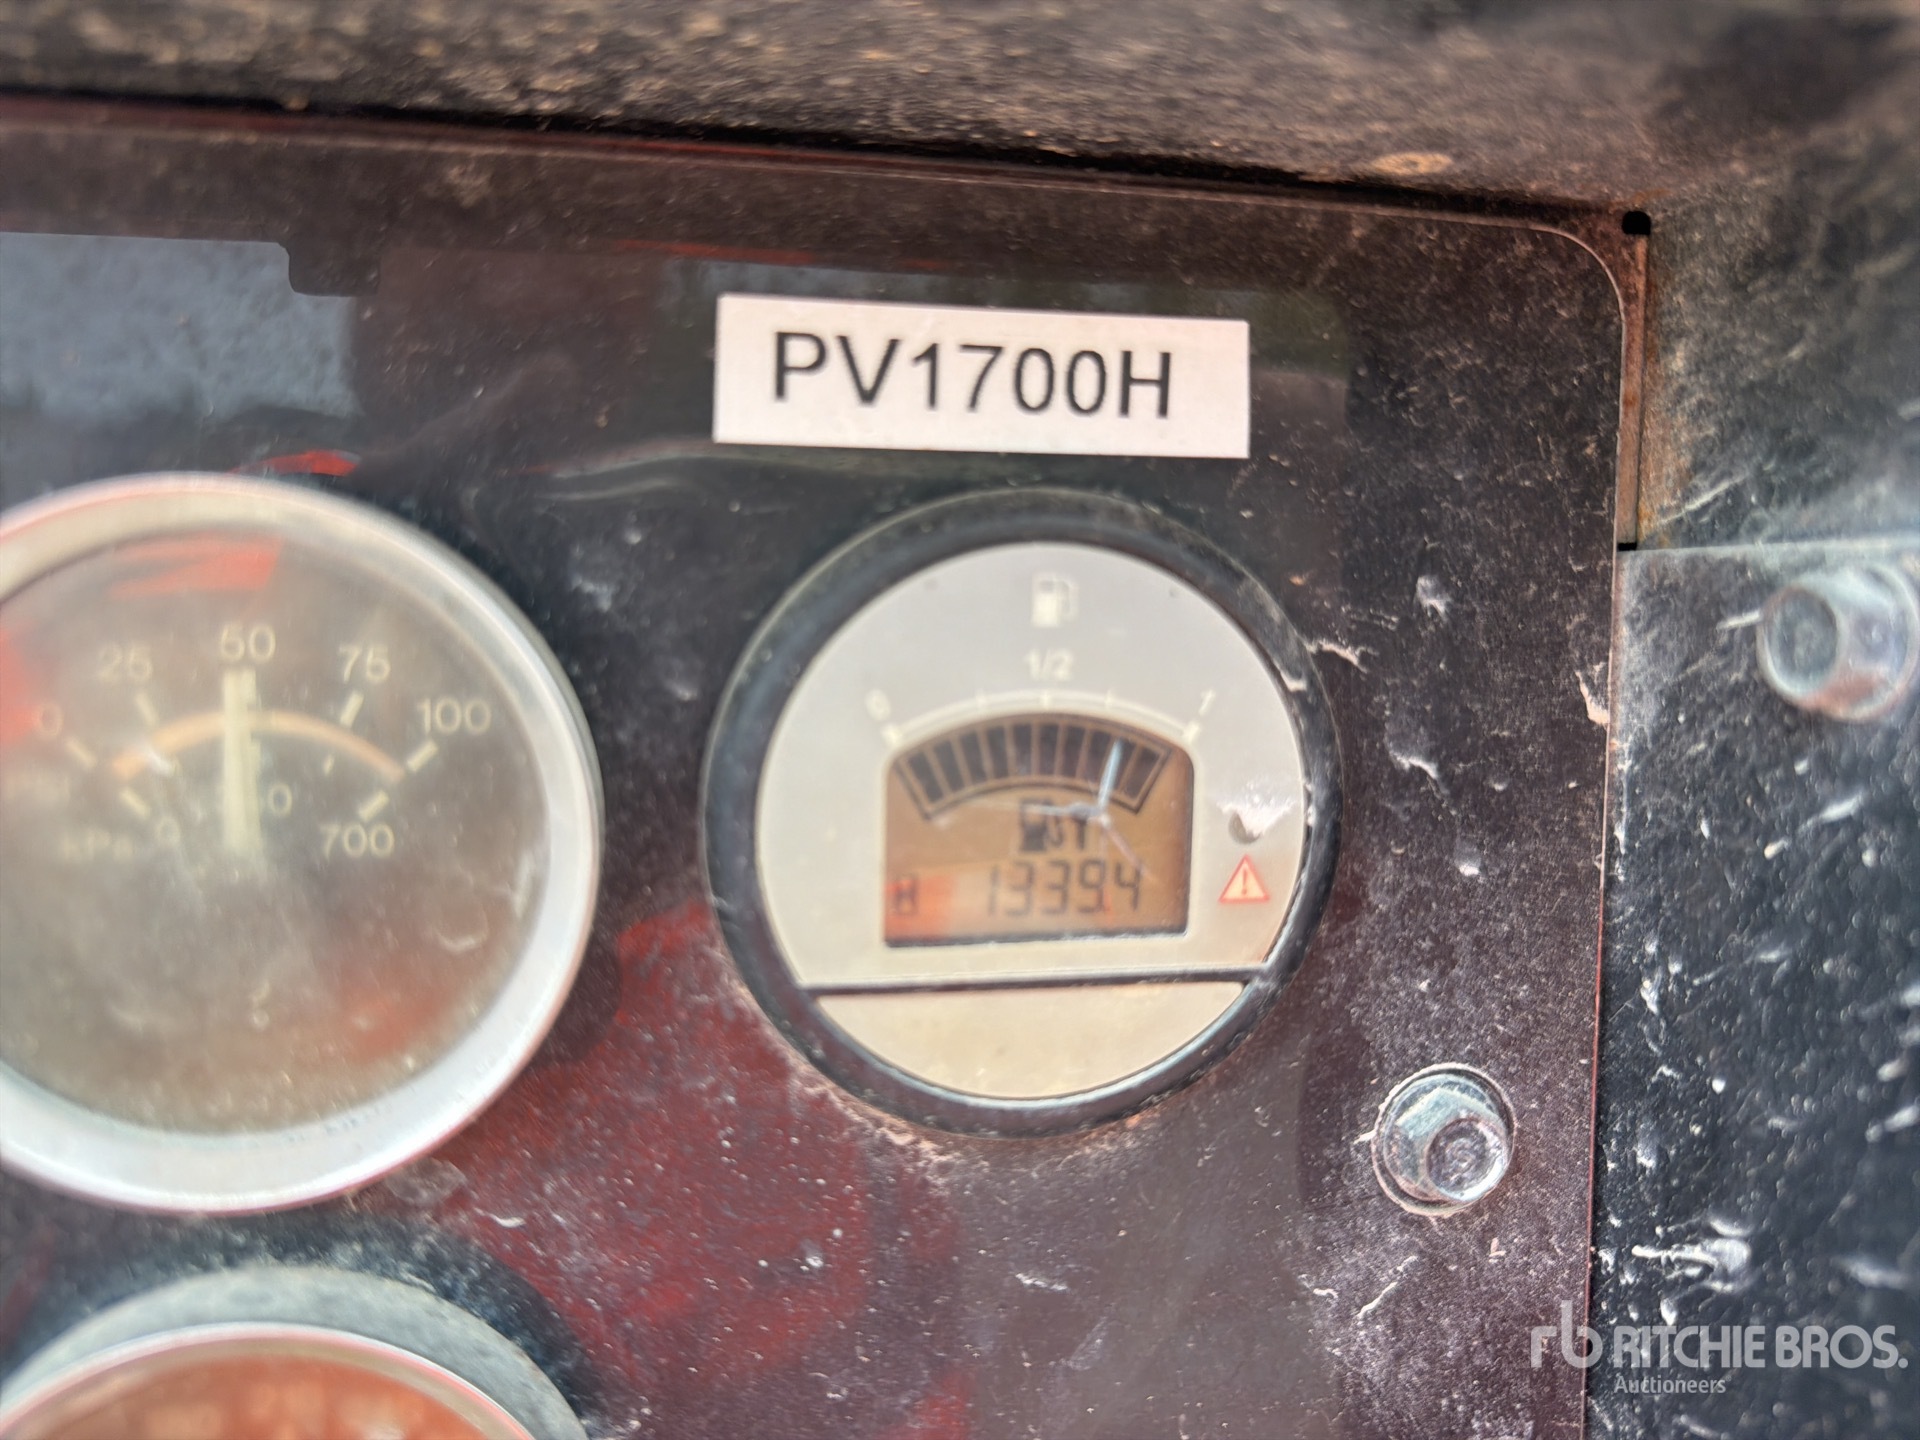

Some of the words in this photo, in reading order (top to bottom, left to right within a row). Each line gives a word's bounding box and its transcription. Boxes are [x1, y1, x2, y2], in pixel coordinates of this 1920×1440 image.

[774, 330, 1173, 418] PV1700H
[98, 641, 154, 682] 25
[219, 622, 277, 664] 50
[338, 643, 392, 684] 75
[1023, 649, 1075, 682] 1/2
[31, 700, 64, 739] 0
[417, 697, 492, 735] 100
[319, 822, 396, 862] 700
